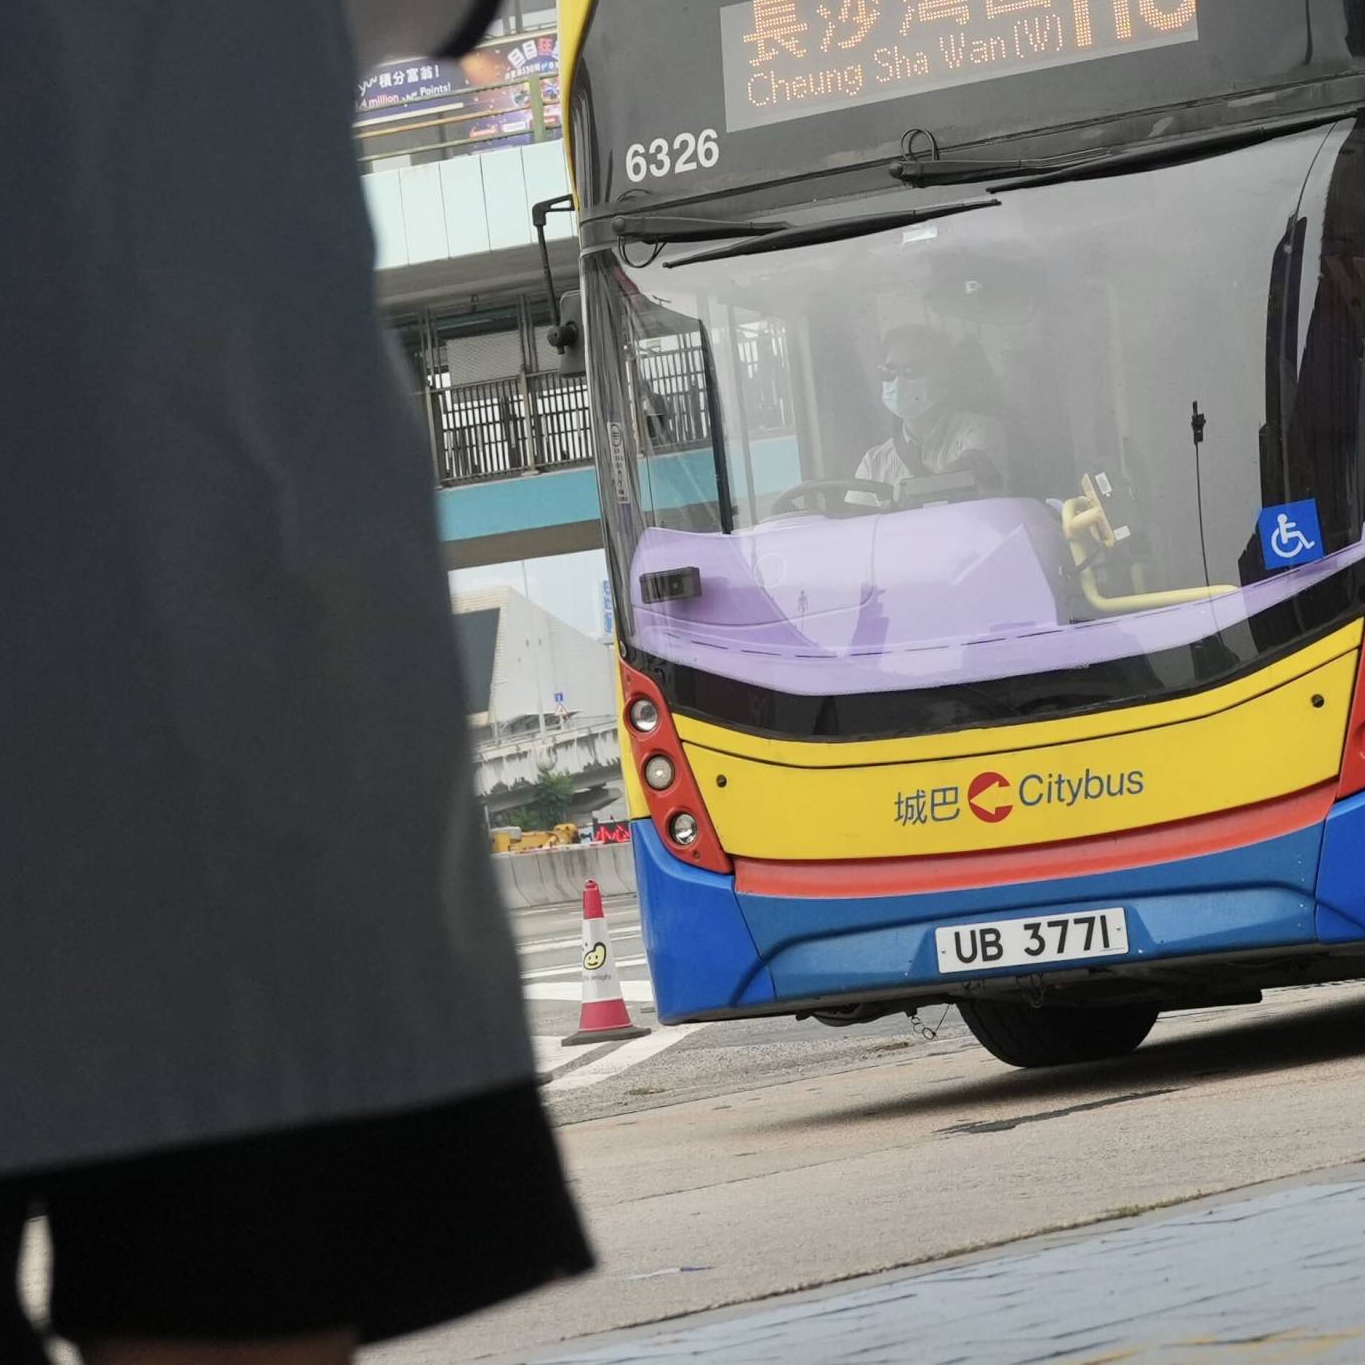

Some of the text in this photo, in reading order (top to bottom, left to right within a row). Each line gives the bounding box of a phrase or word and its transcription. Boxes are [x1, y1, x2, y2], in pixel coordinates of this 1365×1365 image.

[368, 94, 399, 108] million
[420, 83, 451, 97] Points!
[747, 62, 864, 107] Cheung
[873, 45, 930, 83] Sha
[625, 129, 720, 183] 6326
[894, 787, 960, 827] 城巴
[1018, 769, 1145, 809] Citybus
[954, 914, 1109, 965] UB 3771
